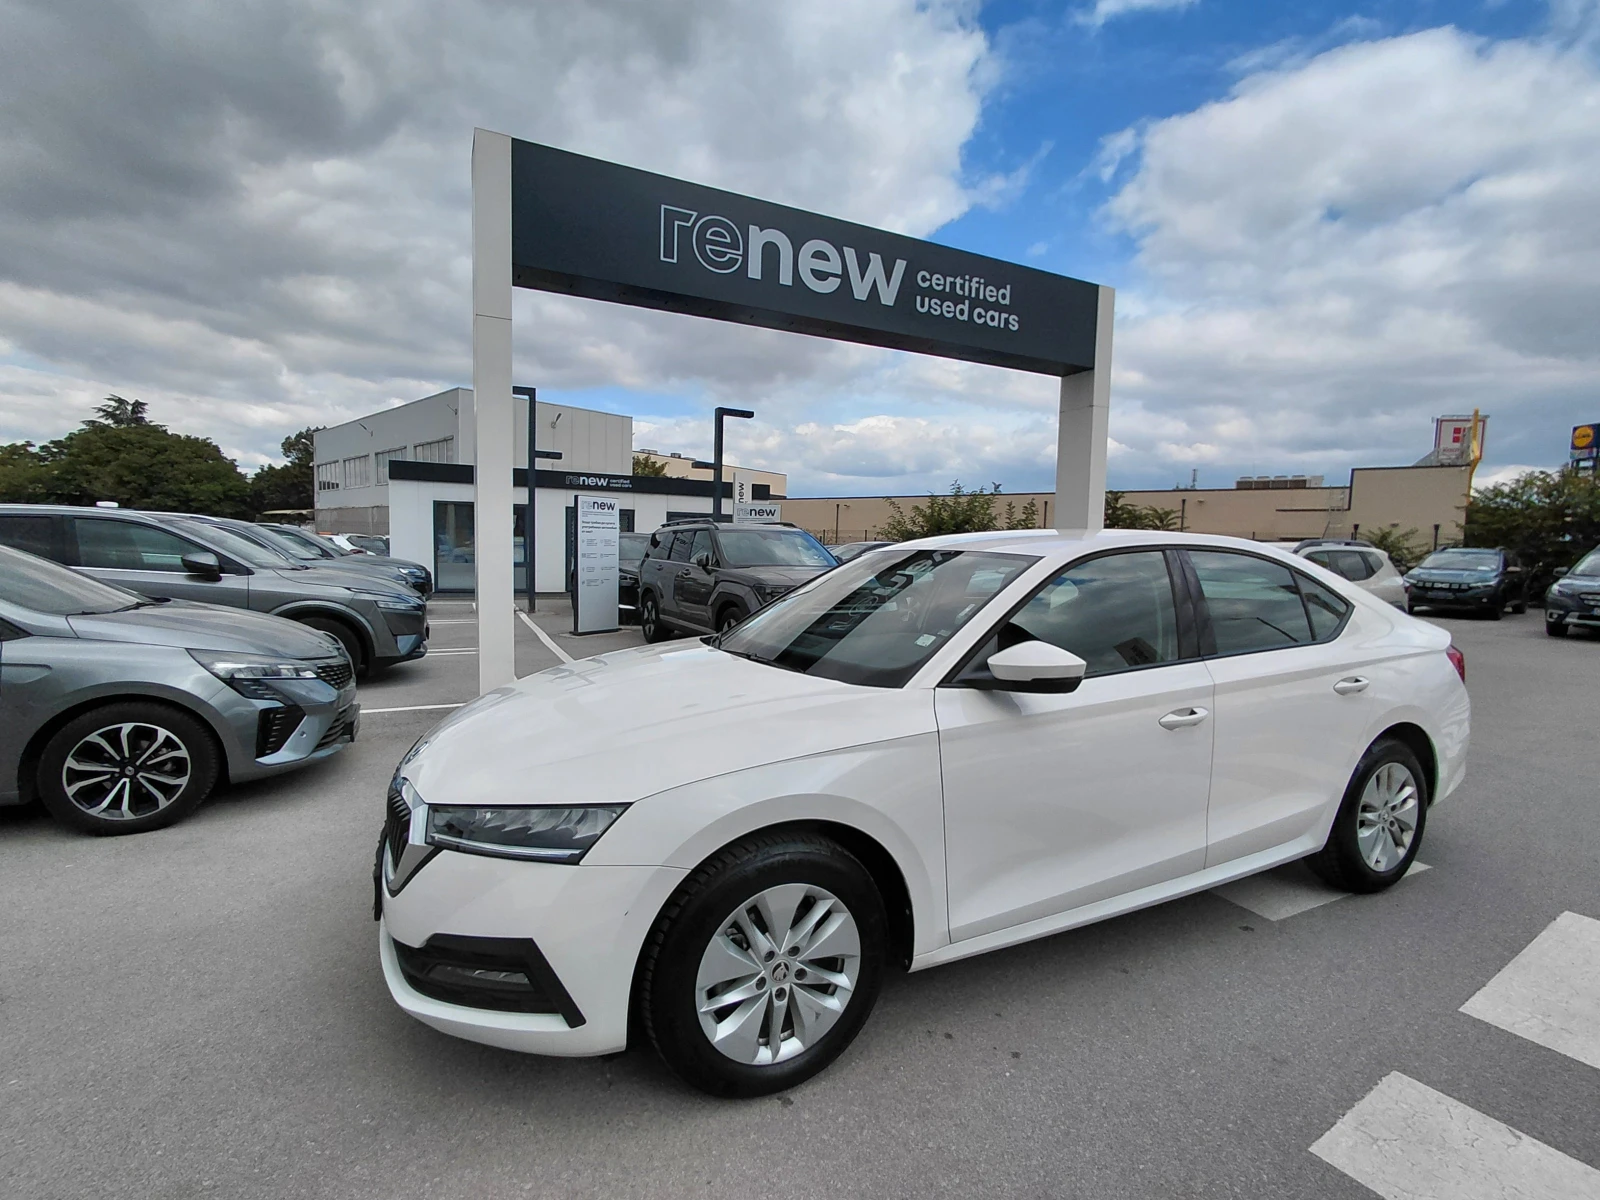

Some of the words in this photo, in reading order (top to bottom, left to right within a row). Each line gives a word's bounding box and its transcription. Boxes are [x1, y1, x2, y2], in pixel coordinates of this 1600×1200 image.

[660, 204, 907, 307] renew
[916, 270, 1011, 306] certified
[916, 294, 970, 321] used
[973, 307, 1020, 332] cars
[565, 475, 609, 487] renew
[581, 500, 616, 511] renew
[736, 507, 777, 517] renew
